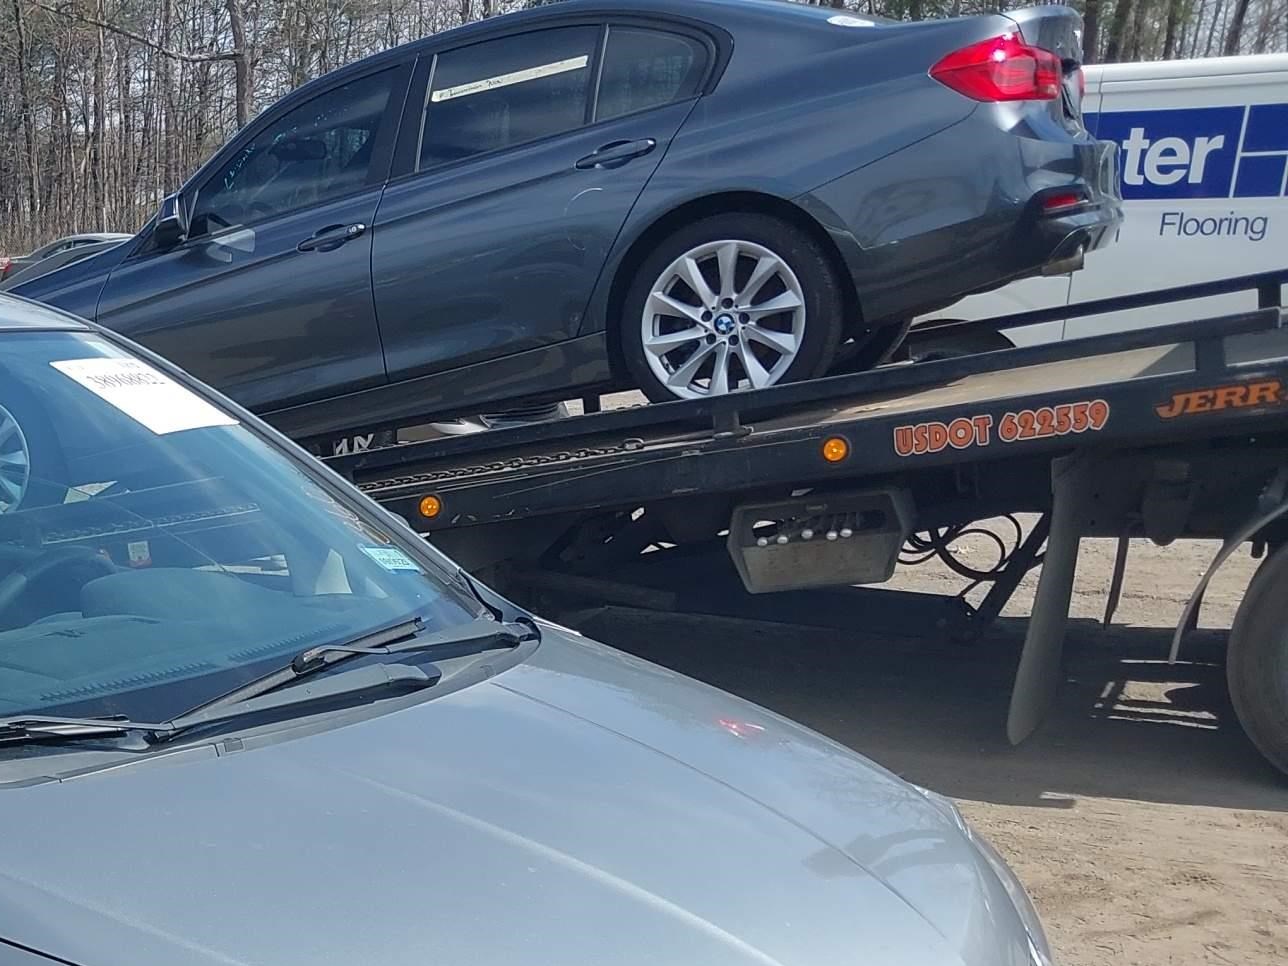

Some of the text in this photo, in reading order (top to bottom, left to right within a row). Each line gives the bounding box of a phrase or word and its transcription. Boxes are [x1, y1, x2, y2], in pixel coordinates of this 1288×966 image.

[1159, 211, 1268, 242] Flooring
[893, 399, 1110, 457] USDOT 622559
